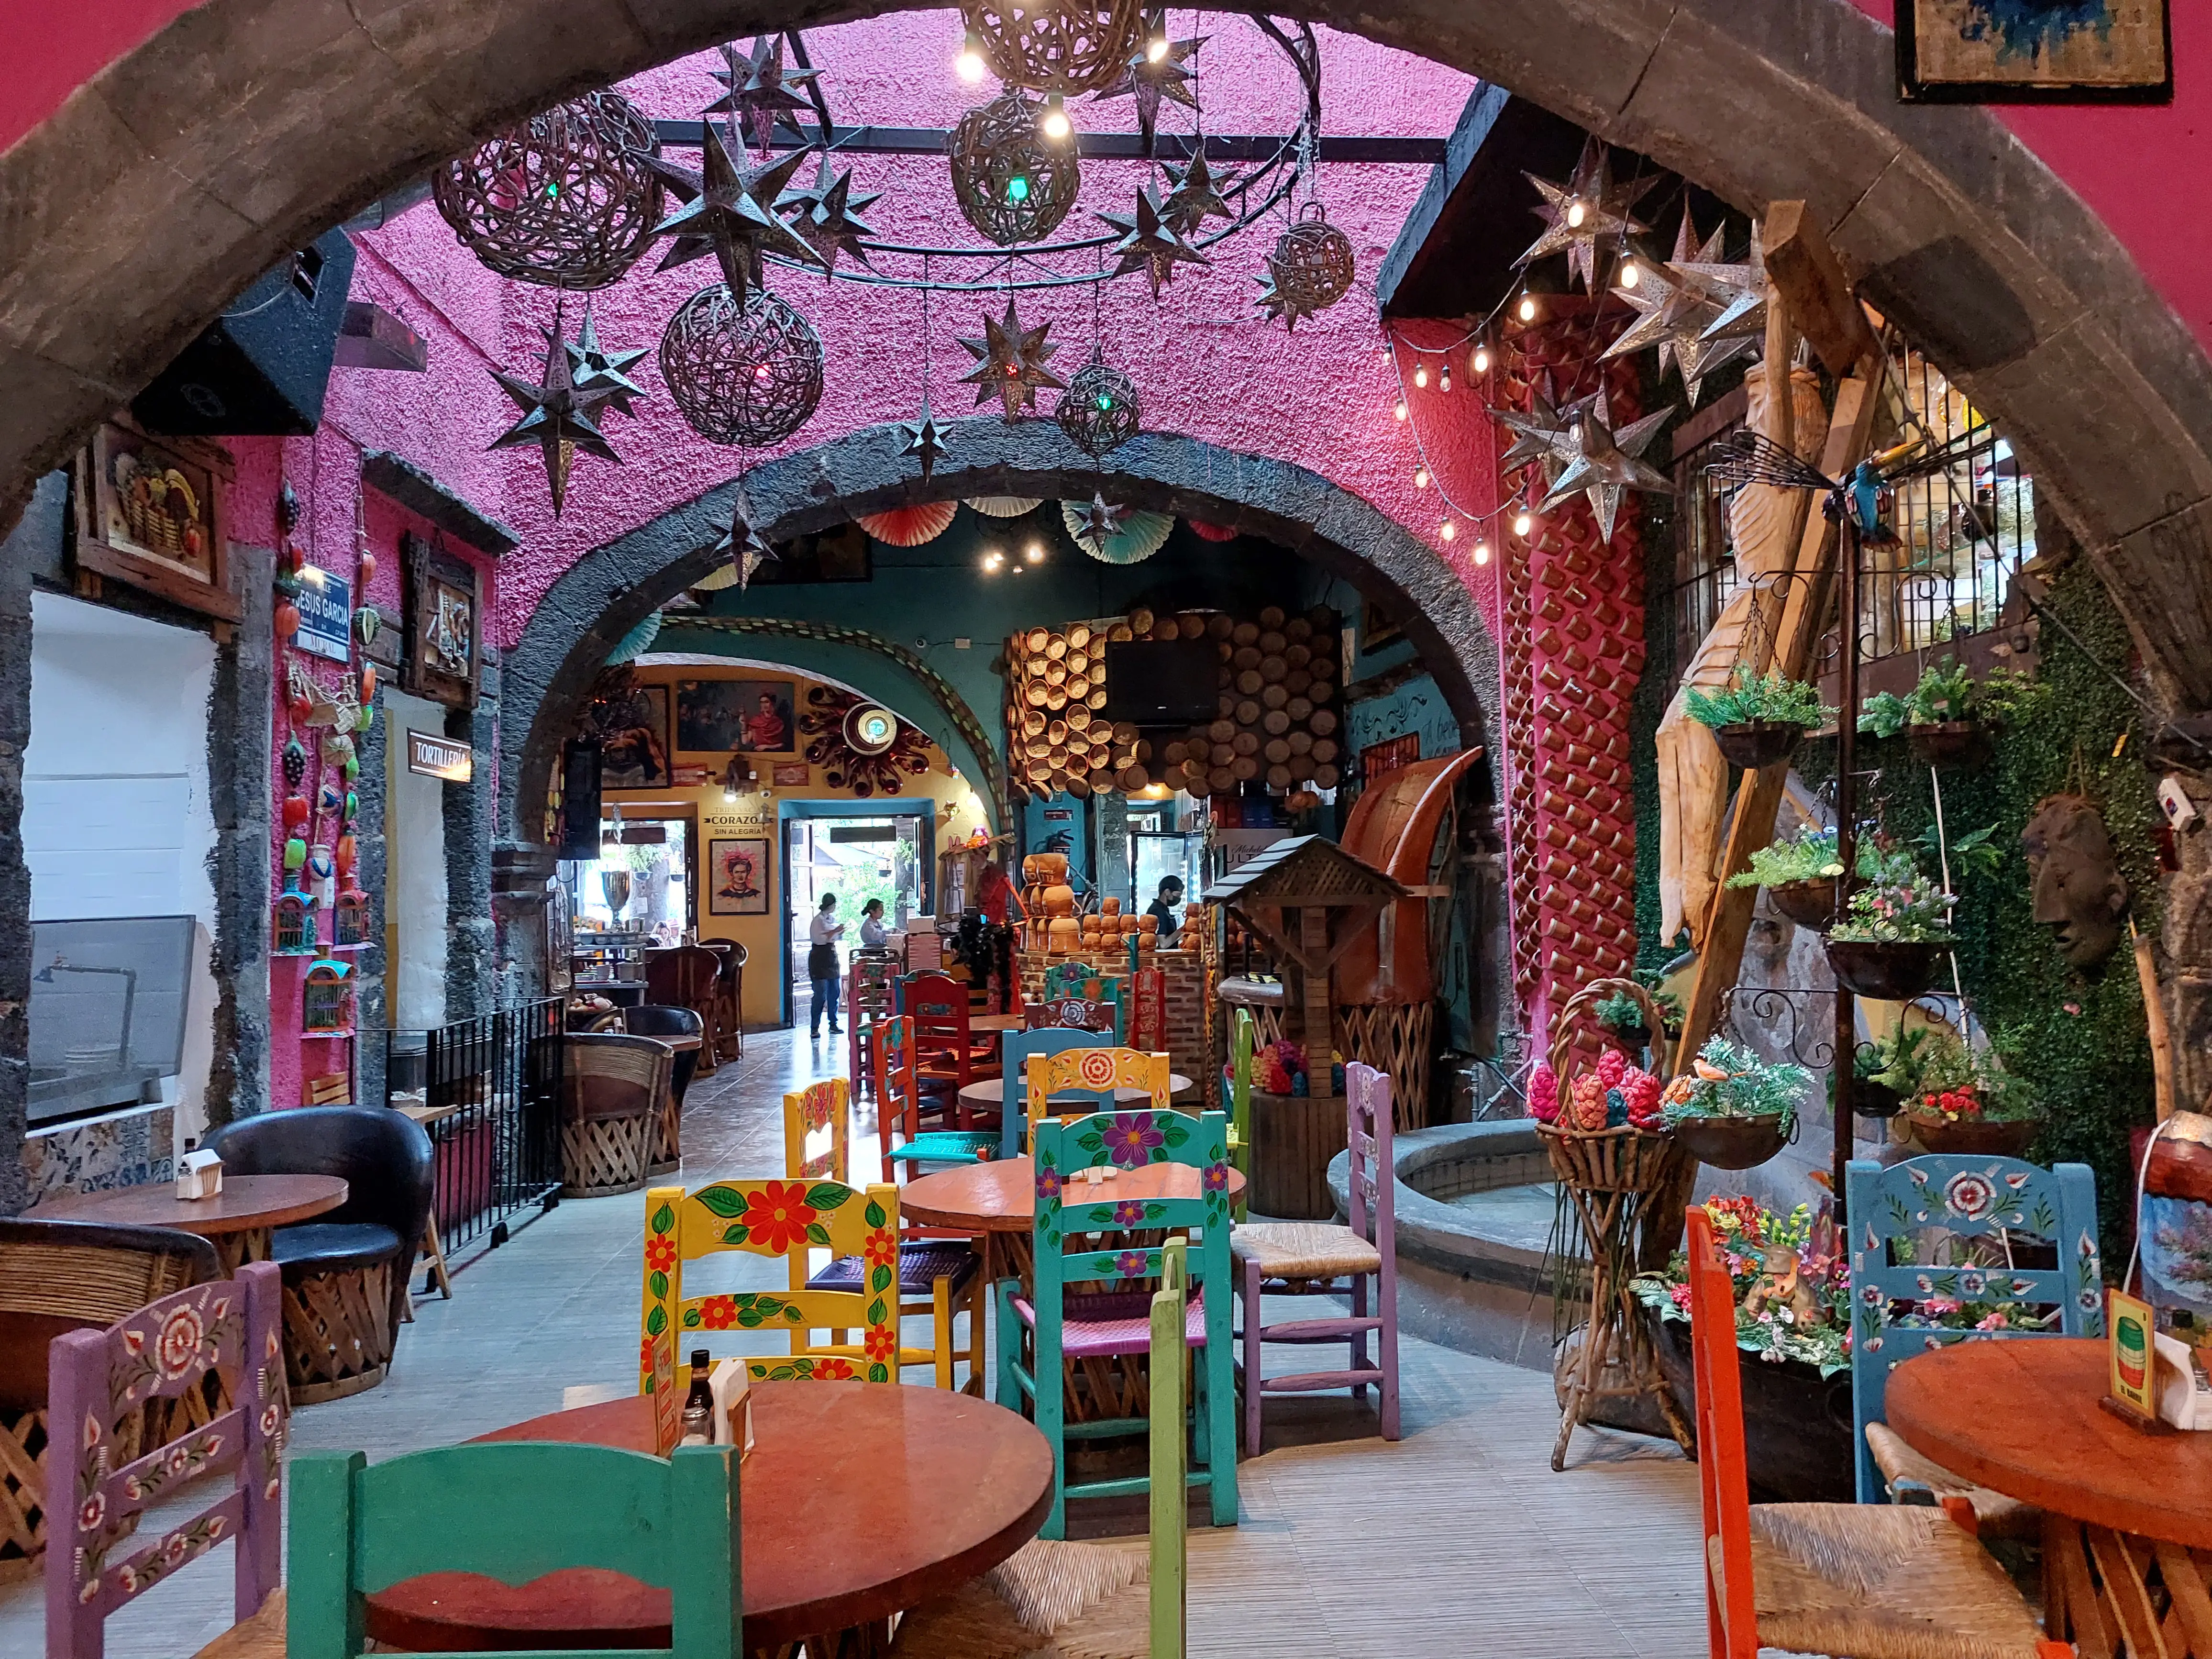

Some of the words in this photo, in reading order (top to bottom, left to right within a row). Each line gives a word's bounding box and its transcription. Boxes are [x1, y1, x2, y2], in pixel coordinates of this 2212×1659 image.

[316, 581, 332, 594] LLE
[296, 589, 321, 616] JESUS
[322, 598, 348, 627] GARCIA
[310, 635, 336, 653] MURAL
[415, 741, 466, 769] TORTILLERÍA
[711, 815, 758, 825] CORAZÓ
[1231, 844, 1268, 853] Michelo
[1227, 854, 1261, 865] ULT
